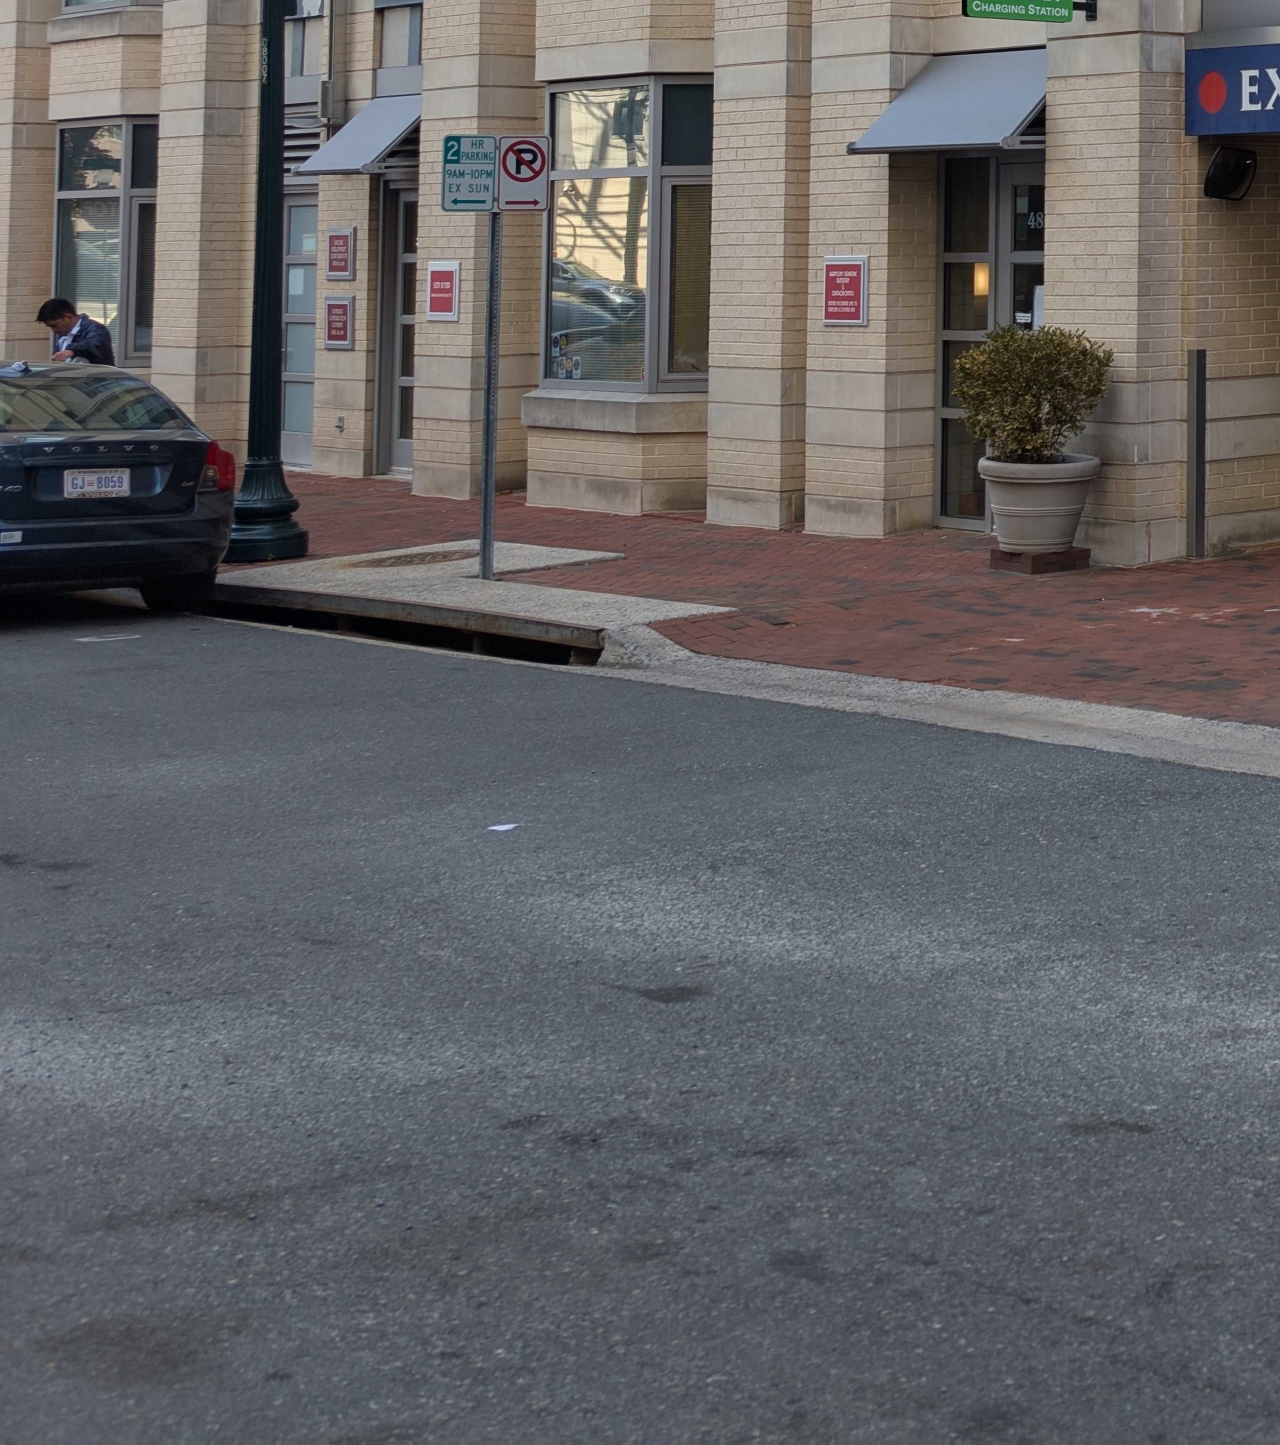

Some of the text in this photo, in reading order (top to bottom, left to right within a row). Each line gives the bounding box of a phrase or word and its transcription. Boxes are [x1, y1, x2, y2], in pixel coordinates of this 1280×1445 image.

[972, 0, 1069, 17] CHARGING STATION
[446, 140, 459, 160] 2
[471, 139, 485, 150] HR
[461, 151, 494, 162] PARKING
[446, 169, 493, 180] 9AM-10PM
[448, 183, 490, 194] EX SUN
[42, 444, 159, 453] VOLVO
